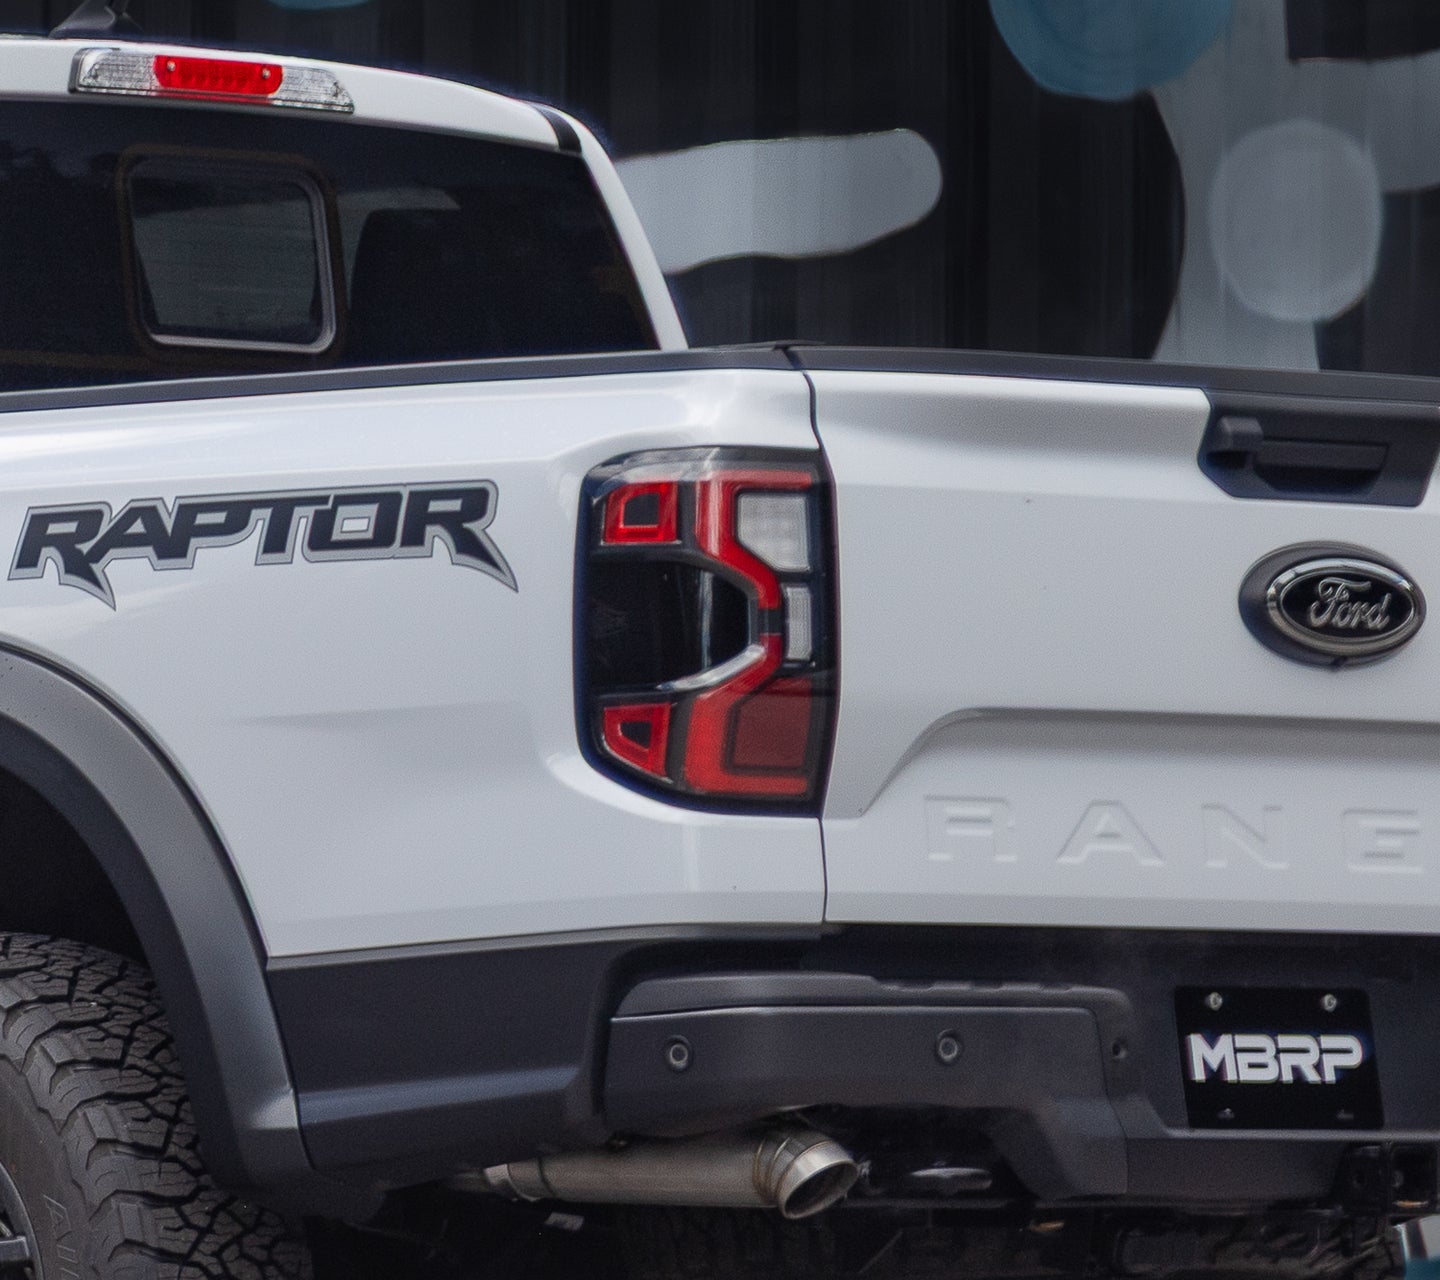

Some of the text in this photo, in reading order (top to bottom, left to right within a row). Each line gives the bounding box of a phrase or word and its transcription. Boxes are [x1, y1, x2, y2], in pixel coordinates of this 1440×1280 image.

[7, 479, 518, 611] RAPTOR
[1308, 576, 1392, 632] Ford
[1186, 1032, 1364, 1085] MBRP
